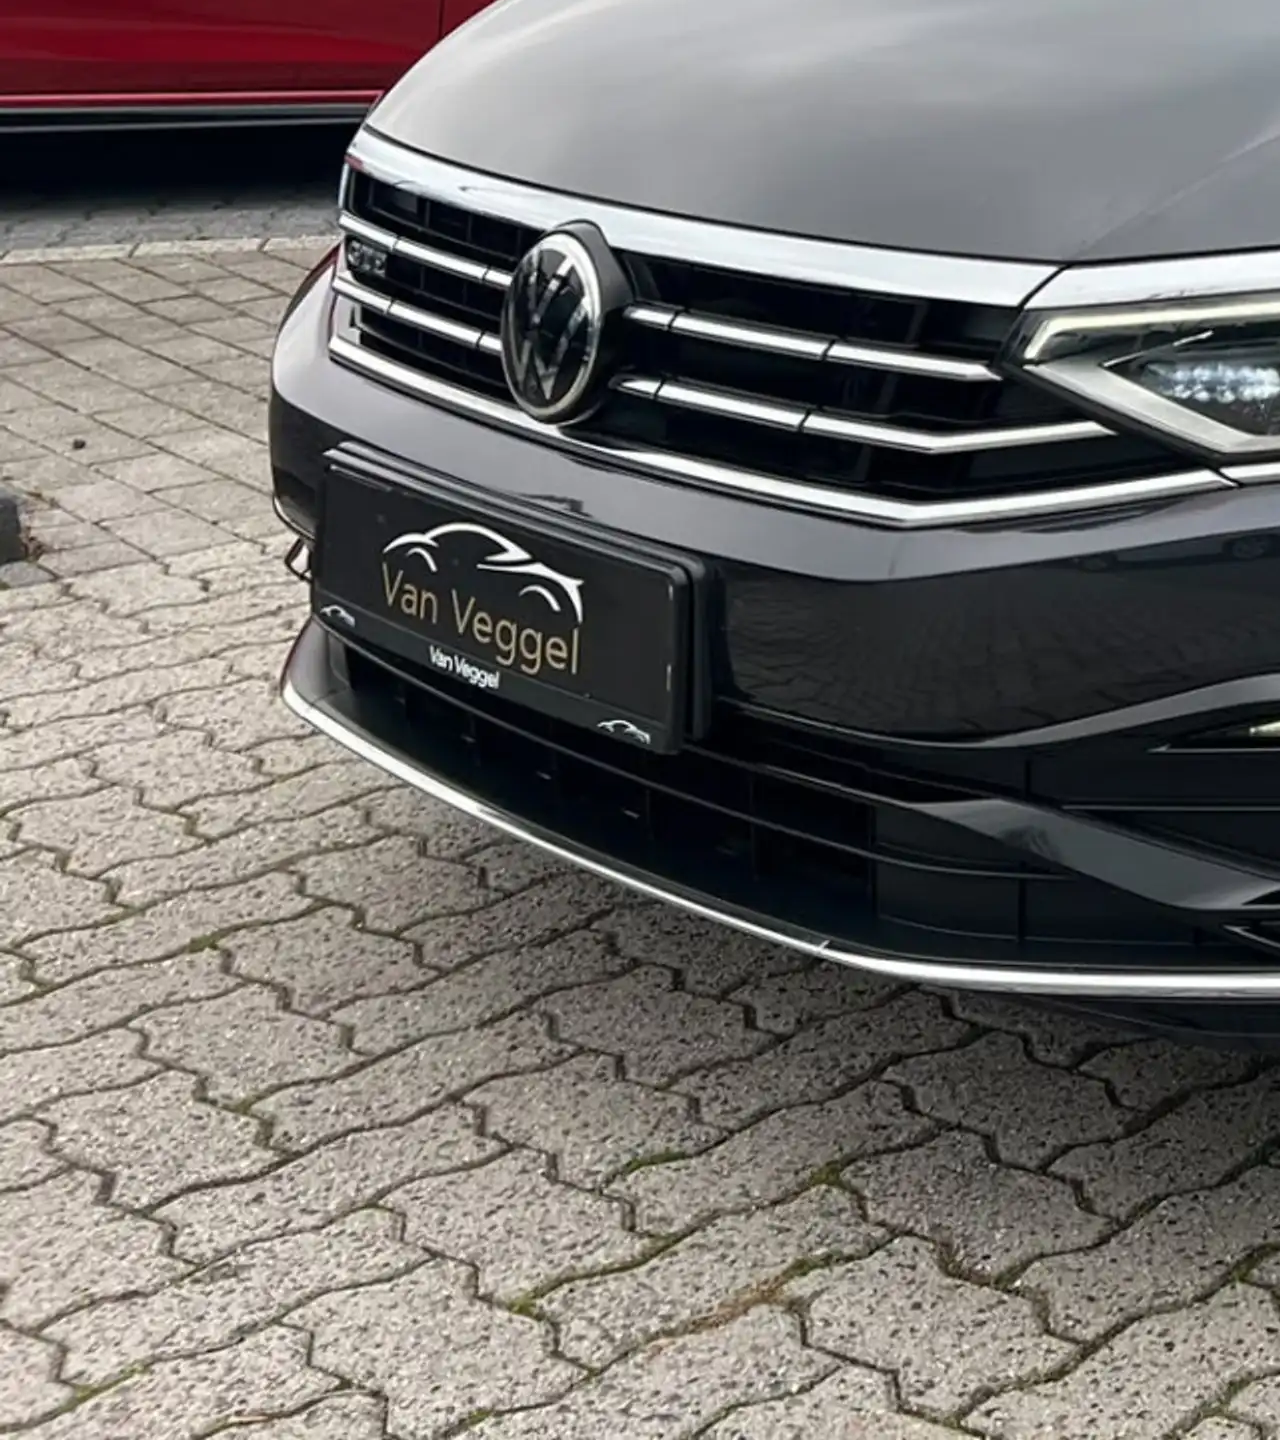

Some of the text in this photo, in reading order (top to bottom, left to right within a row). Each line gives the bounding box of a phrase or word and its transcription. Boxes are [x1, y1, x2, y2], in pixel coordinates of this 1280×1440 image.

[382, 562, 580, 675] Van Veggel
[429, 644, 500, 690] Van Veggel
